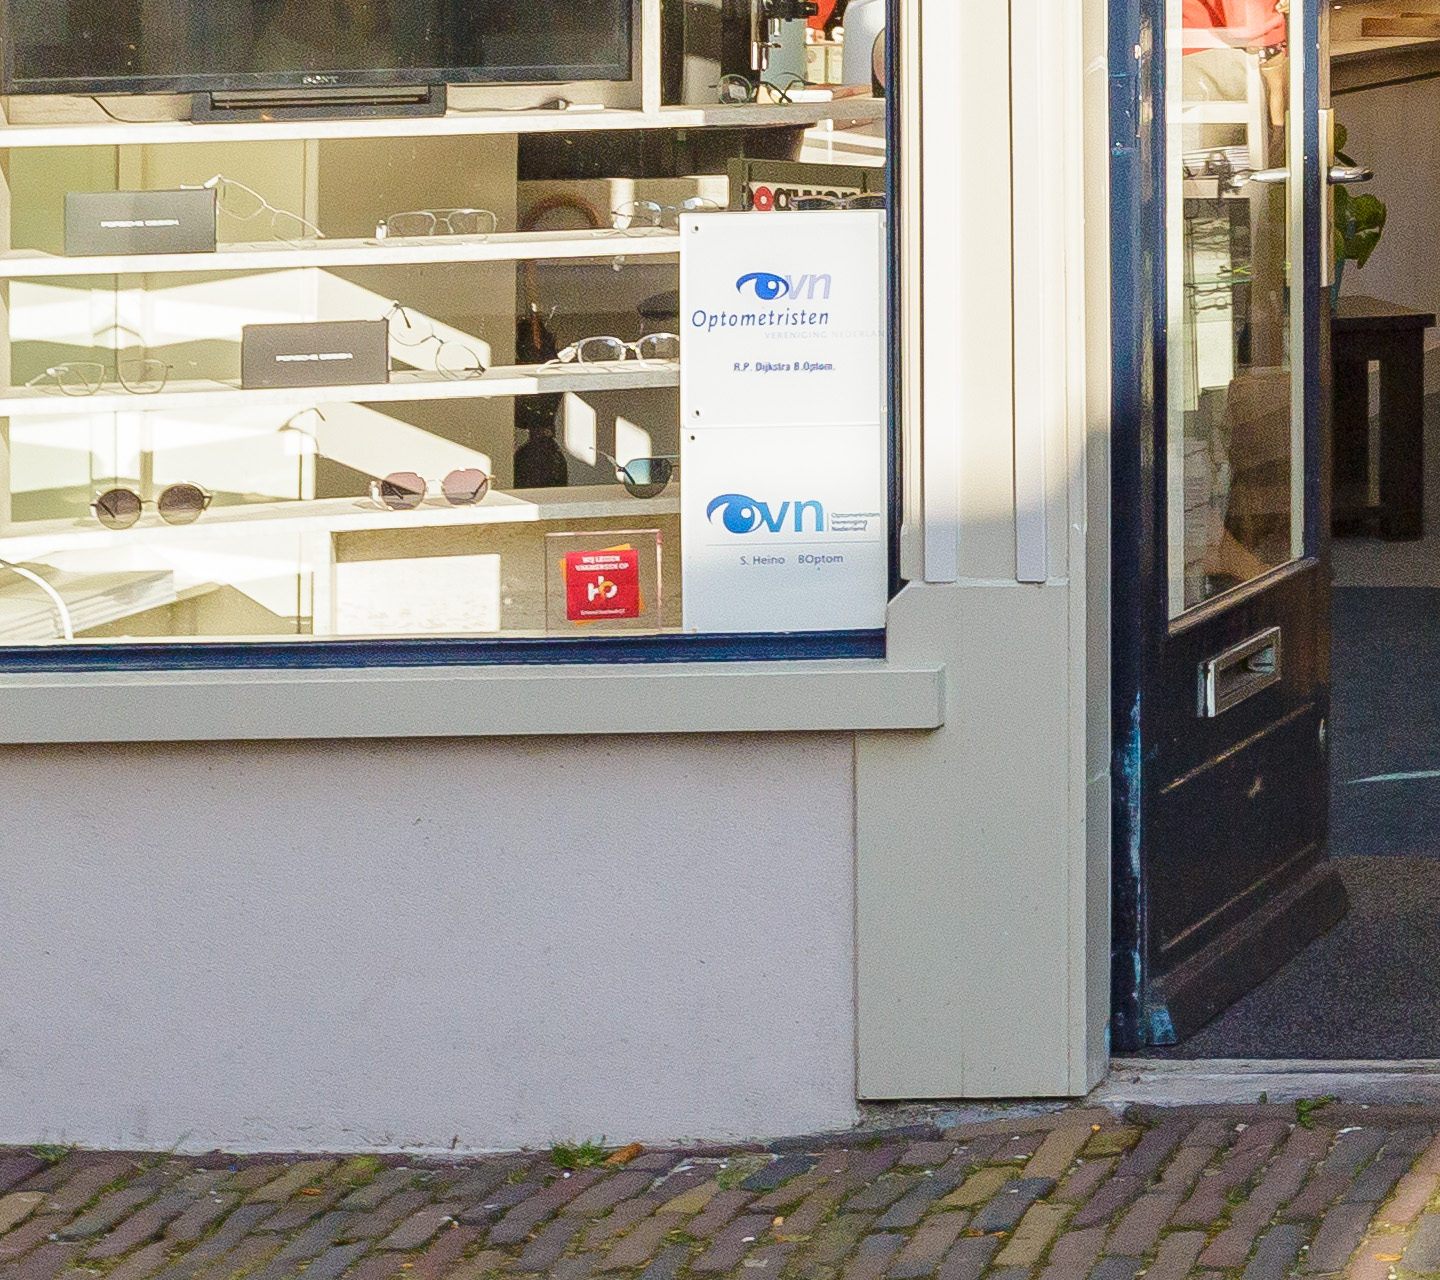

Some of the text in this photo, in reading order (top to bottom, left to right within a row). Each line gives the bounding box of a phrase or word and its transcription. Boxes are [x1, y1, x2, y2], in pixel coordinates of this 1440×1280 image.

[692, 308, 829, 332] Optometristen
[756, 361, 791, 374] Dijkstra
[753, 555, 786, 566] Heino
